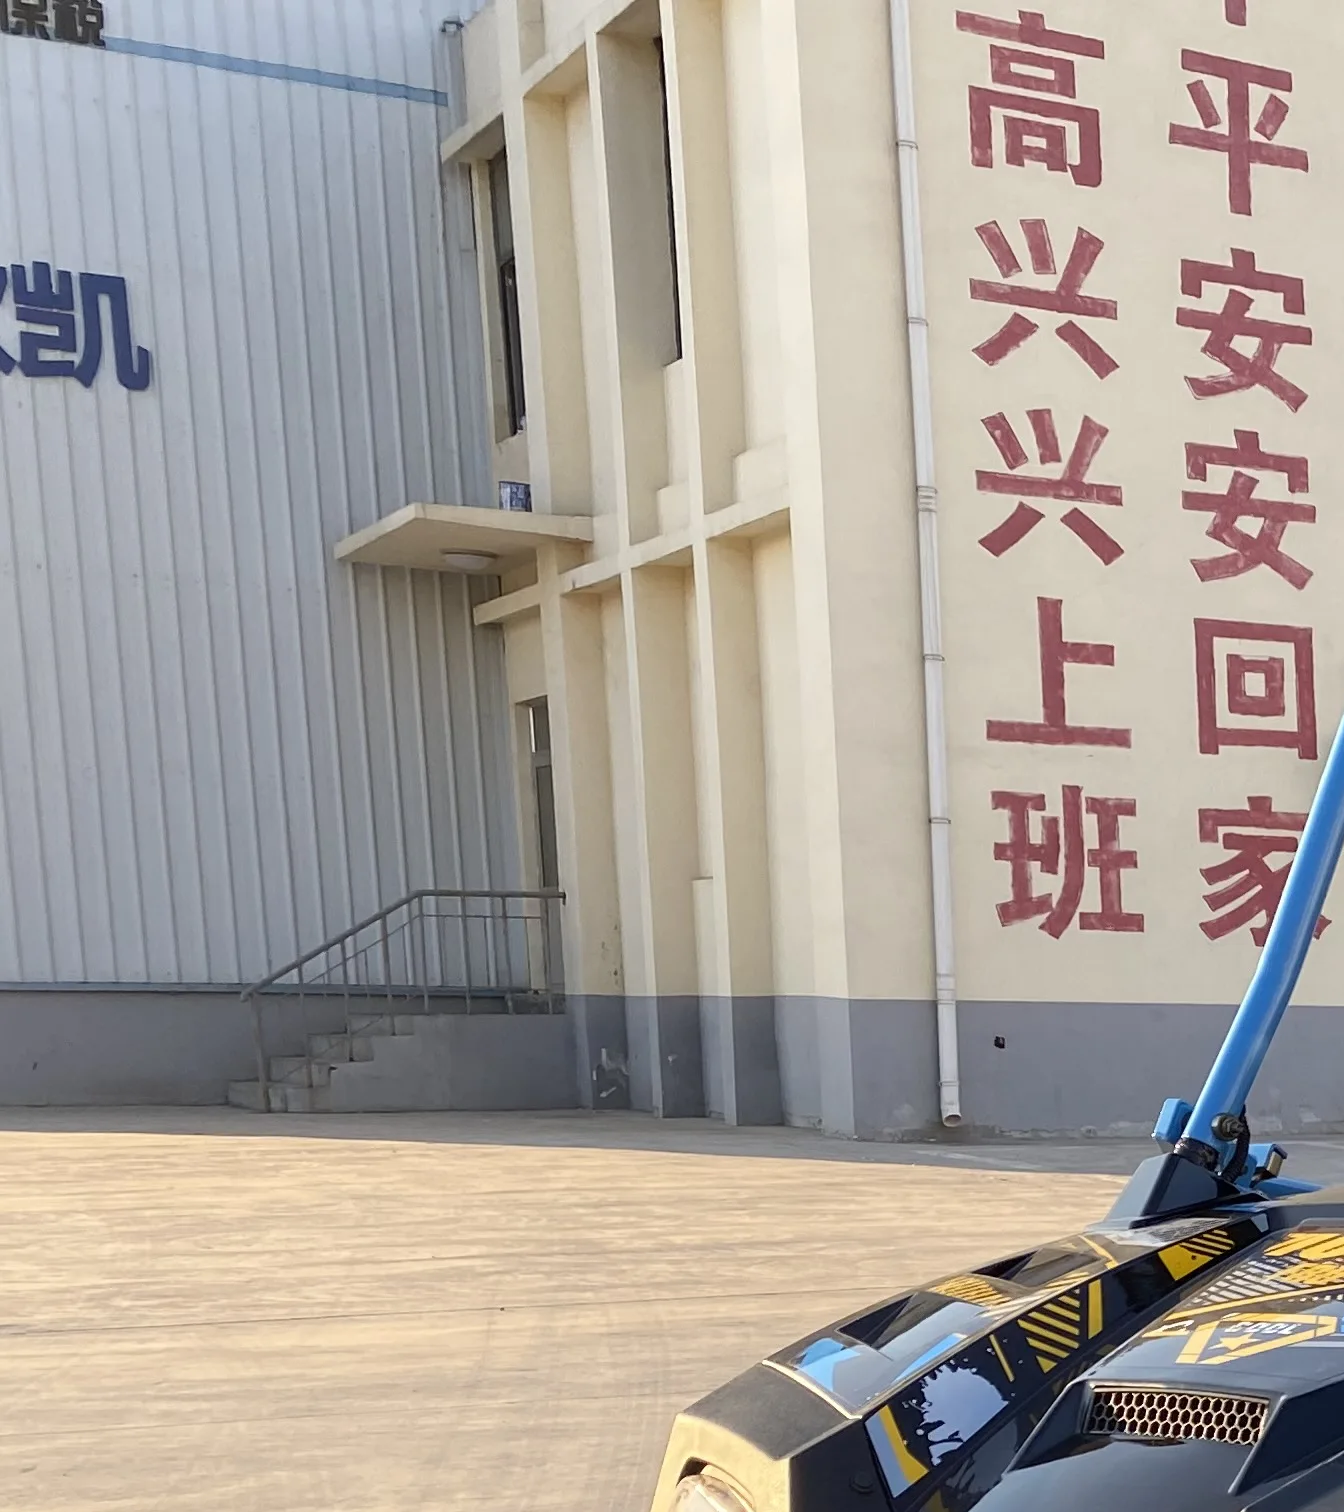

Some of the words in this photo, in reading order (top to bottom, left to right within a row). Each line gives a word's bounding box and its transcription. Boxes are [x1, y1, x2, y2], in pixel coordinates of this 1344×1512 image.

[0, 261, 150, 391] 凯
[955, 10, 1145, 940] 高兴兴上班
[1169, 0, 1332, 948] 平安安回家
